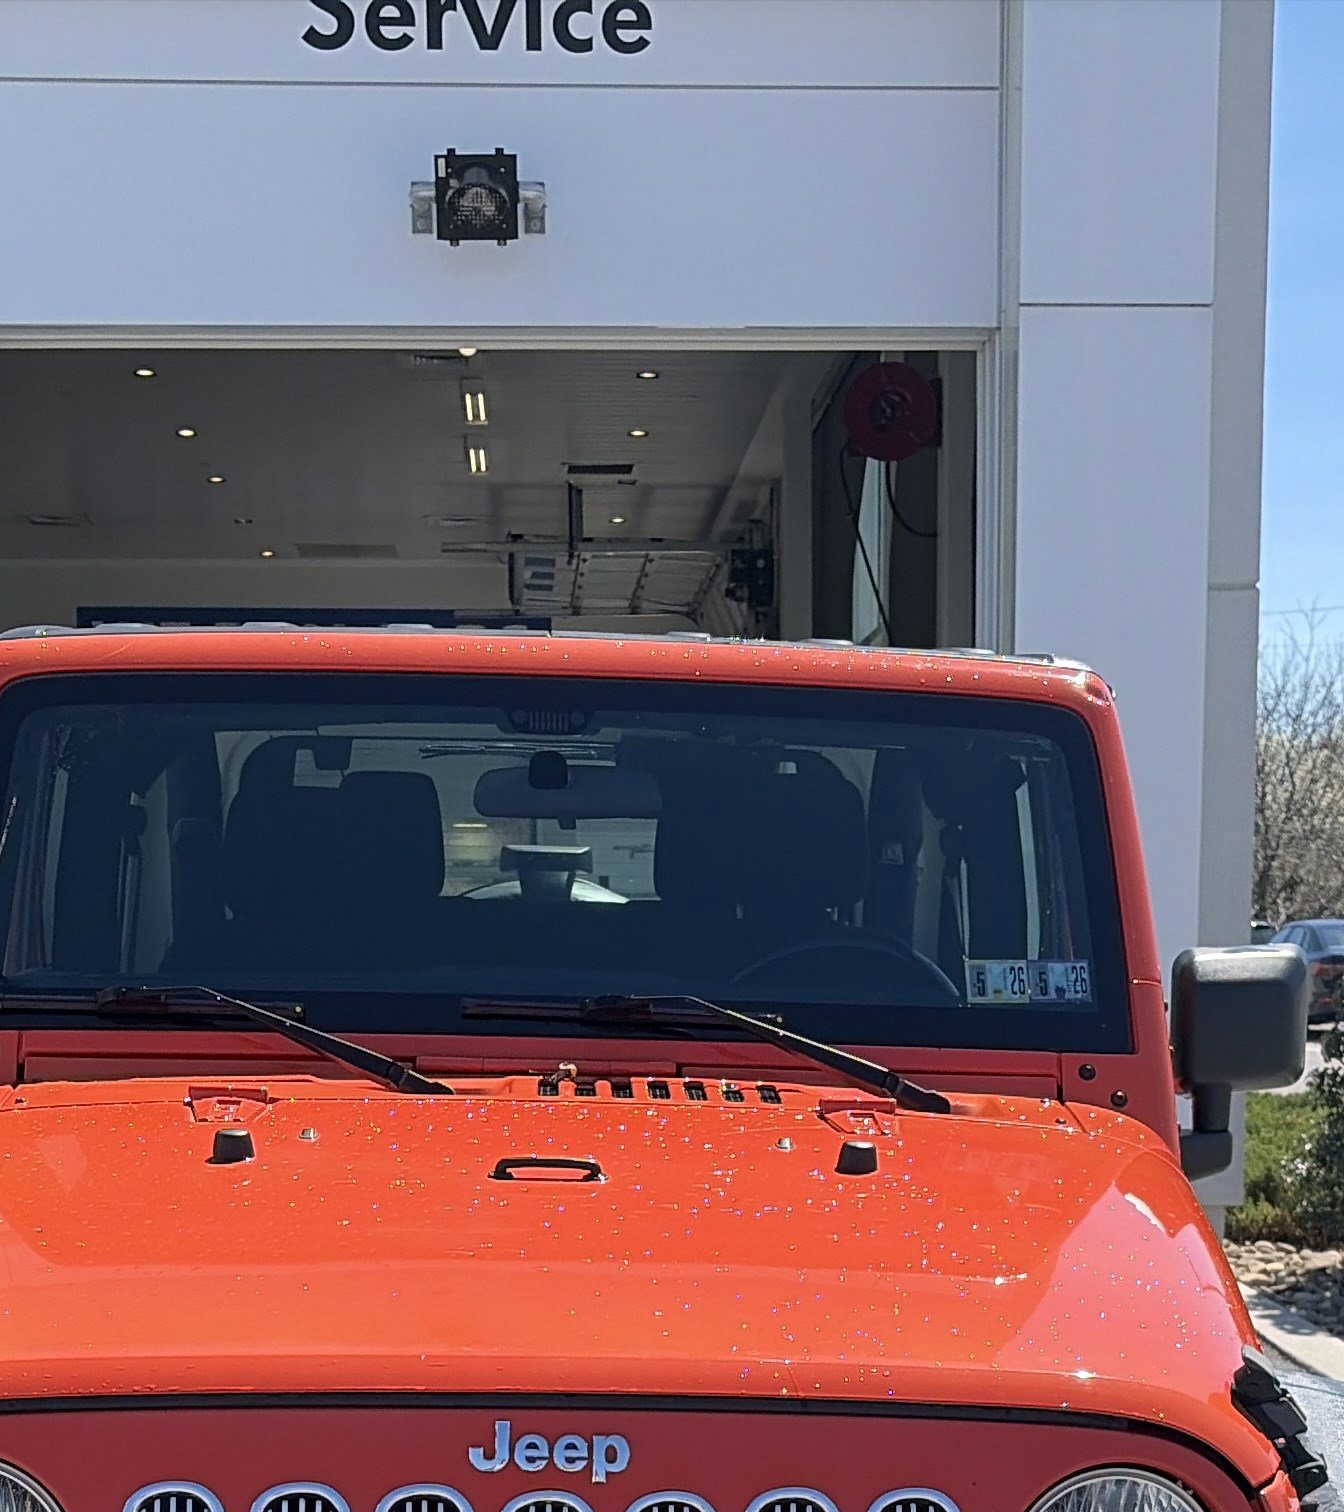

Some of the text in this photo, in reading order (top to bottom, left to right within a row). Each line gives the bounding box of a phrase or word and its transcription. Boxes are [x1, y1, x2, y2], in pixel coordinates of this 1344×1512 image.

[302, 0, 653, 54] Service
[1009, 966, 1026, 996] 26
[1071, 965, 1088, 995] 26
[468, 1420, 631, 1484] Jeep
